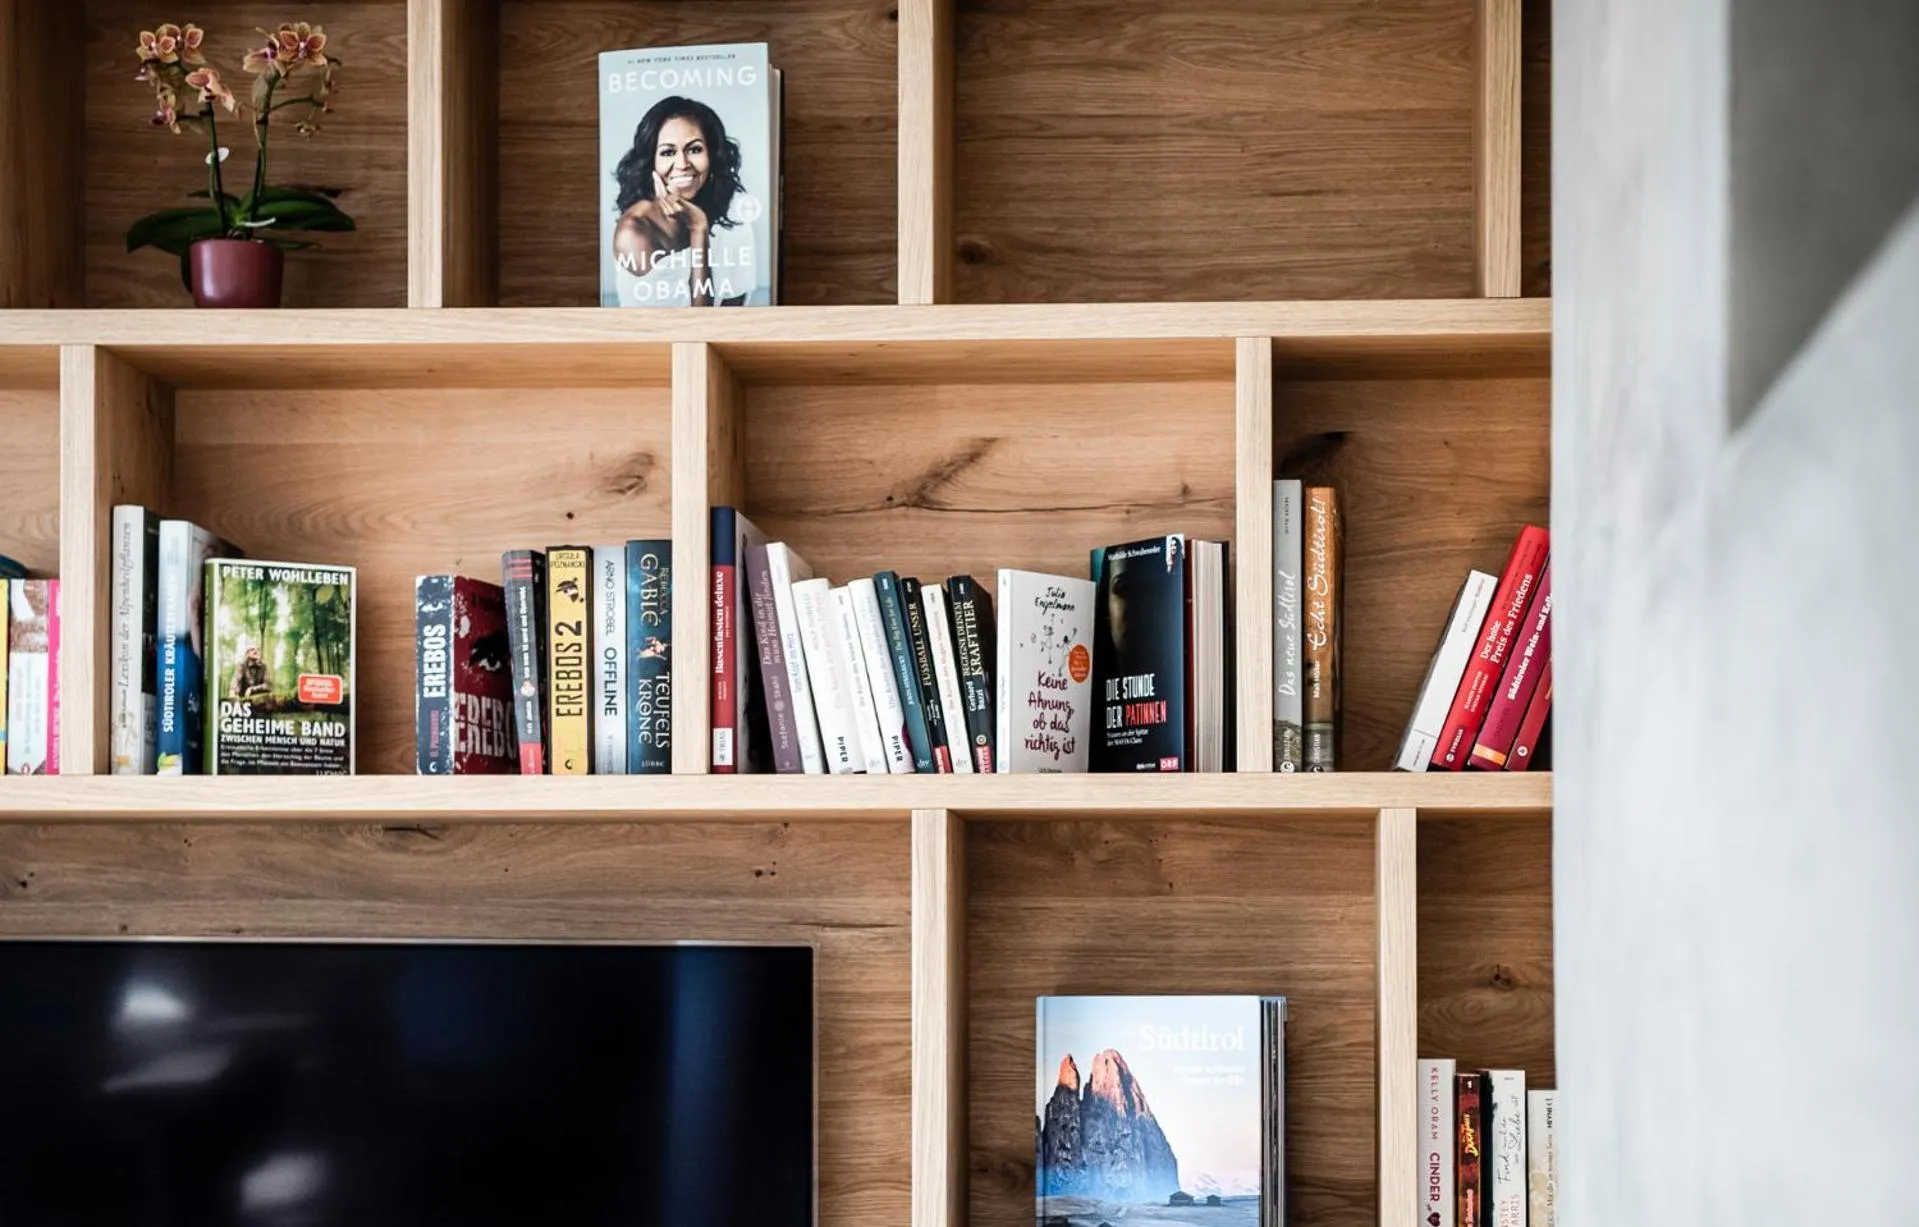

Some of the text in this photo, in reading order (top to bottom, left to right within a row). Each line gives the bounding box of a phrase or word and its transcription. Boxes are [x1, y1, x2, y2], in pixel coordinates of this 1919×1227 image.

[608, 66, 757, 93] BECOMING
[615, 247, 753, 272] MICHELLE
[633, 277, 734, 301] OBAMA
[222, 566, 349, 585] PETER WOHLLEBEN
[714, 571, 725, 607] deluxe
[760, 570, 771, 599] finden
[1306, 497, 1328, 651] Echt Südtirol!
[605, 560, 615, 636] ARNO STROBEL
[1034, 596, 1075, 615] Engelmann
[1045, 586, 1066, 599] Julia
[1278, 569, 1296, 631] Südtirol
[1505, 571, 1536, 620] Friedens
[753, 592, 772, 665] Das Kind in dir
[766, 602, 777, 637] Heimat
[1500, 618, 1515, 636] des
[714, 608, 725, 674] Basenfasten
[908, 603, 932, 686] FUSSBALL UNSER
[953, 601, 971, 677] BEGEGNE DEINEM
[963, 600, 983, 676] KRAFTTIER
[1478, 618, 1502, 660] Der hohe
[1488, 634, 1509, 663] Preis
[423, 624, 446, 698] EREBOS
[555, 620, 583, 717] EREBOS 2
[1506, 655, 1530, 700] Südtiroler
[1533, 613, 1546, 631] und
[604, 647, 618, 717] OFFLINE
[966, 681, 976, 712] Gerhard
[1037, 670, 1067, 690] Keine
[1106, 673, 1155, 701] DIE STUNDE
[1278, 671, 1296, 696] Das
[163, 669, 175, 732] SÜDTIROLER
[220, 701, 251, 717] DAS
[637, 679, 652, 745] KRONE
[654, 672, 670, 749] TEUFELS
[771, 676, 789, 749] Stefanie Stahl
[1106, 700, 1167, 729] DER PATINNEN
[220, 718, 346, 738] GEHEIME BAND
[1033, 712, 1070, 733] ob das
[220, 734, 346, 747] ZWISCHEN MENSCH UND NATUR
[837, 736, 848, 762] PIPER
[894, 735, 903, 761] PIPER
[1025, 732, 1076, 760] richtig ist
[1139, 1024, 1246, 1052] Südtirol
[1430, 1067, 1439, 1140] KELLY ORAM
[1429, 1152, 1440, 1202] CINDER
